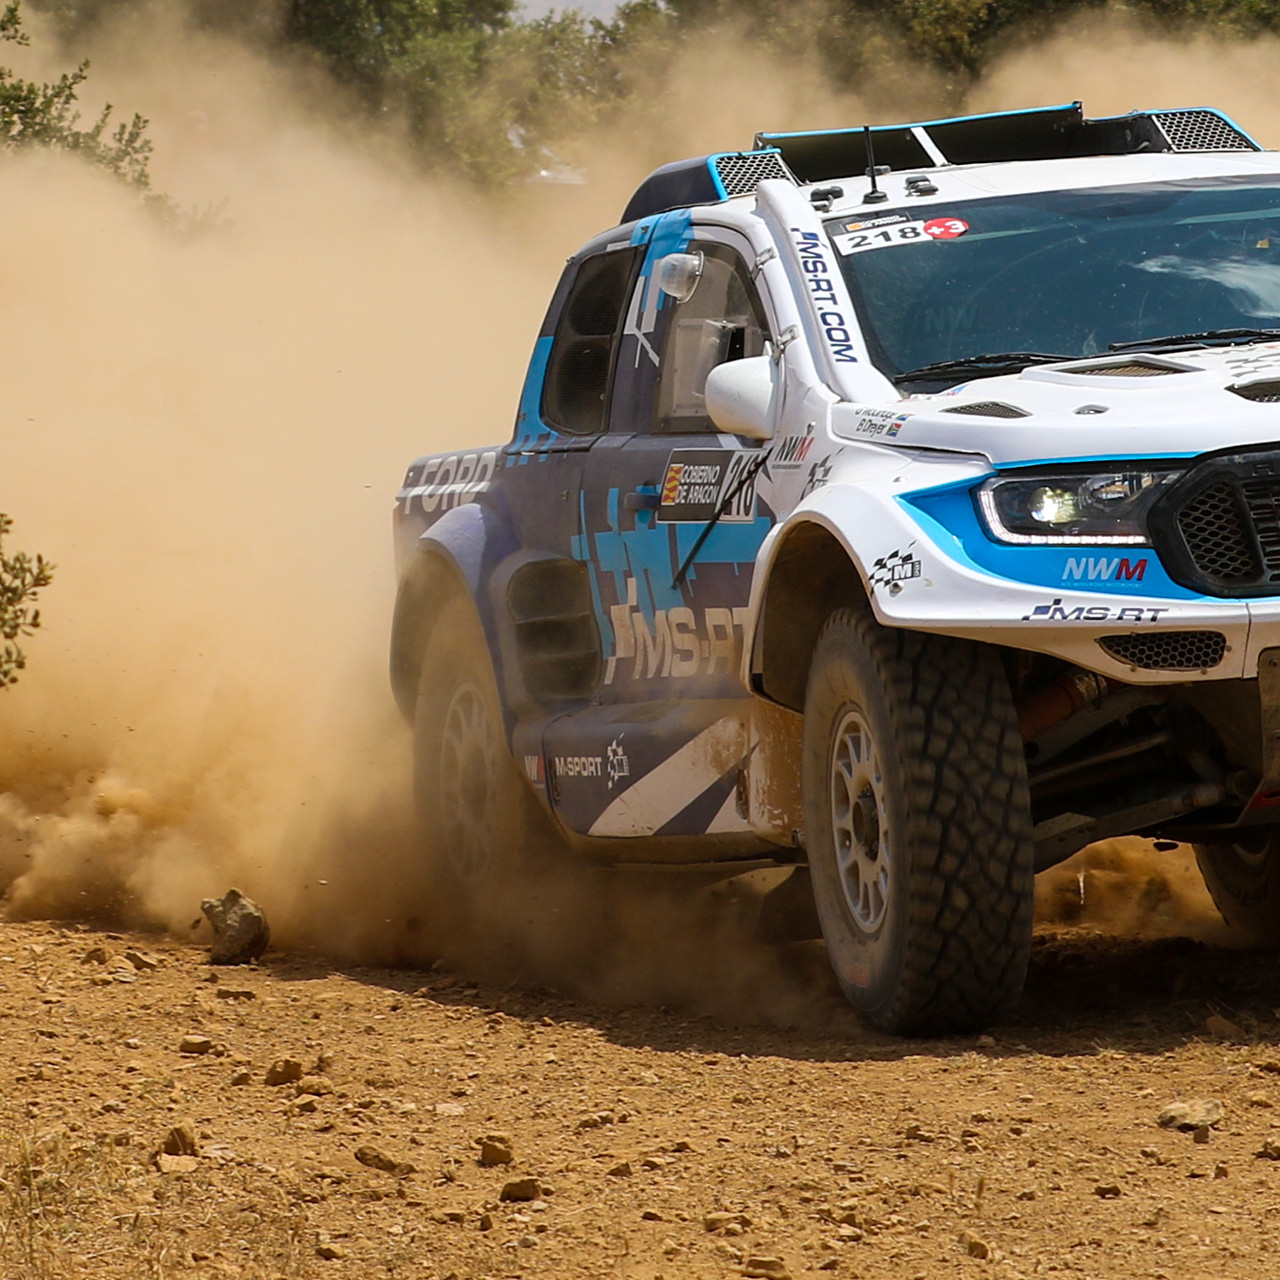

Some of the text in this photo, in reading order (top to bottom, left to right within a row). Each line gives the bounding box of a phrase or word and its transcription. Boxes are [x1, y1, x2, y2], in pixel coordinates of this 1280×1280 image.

[847, 226, 922, 249] 218
[856, 418, 866, 432] B
[774, 436, 815, 462] NWM
[404, 451, 496, 515] FORD
[681, 465, 720, 484] GOBIERNO
[723, 454, 760, 517] 218
[676, 485, 688, 504] DE
[1062, 557, 1148, 581] NWM
[1048, 606, 1170, 622] MS-RT
